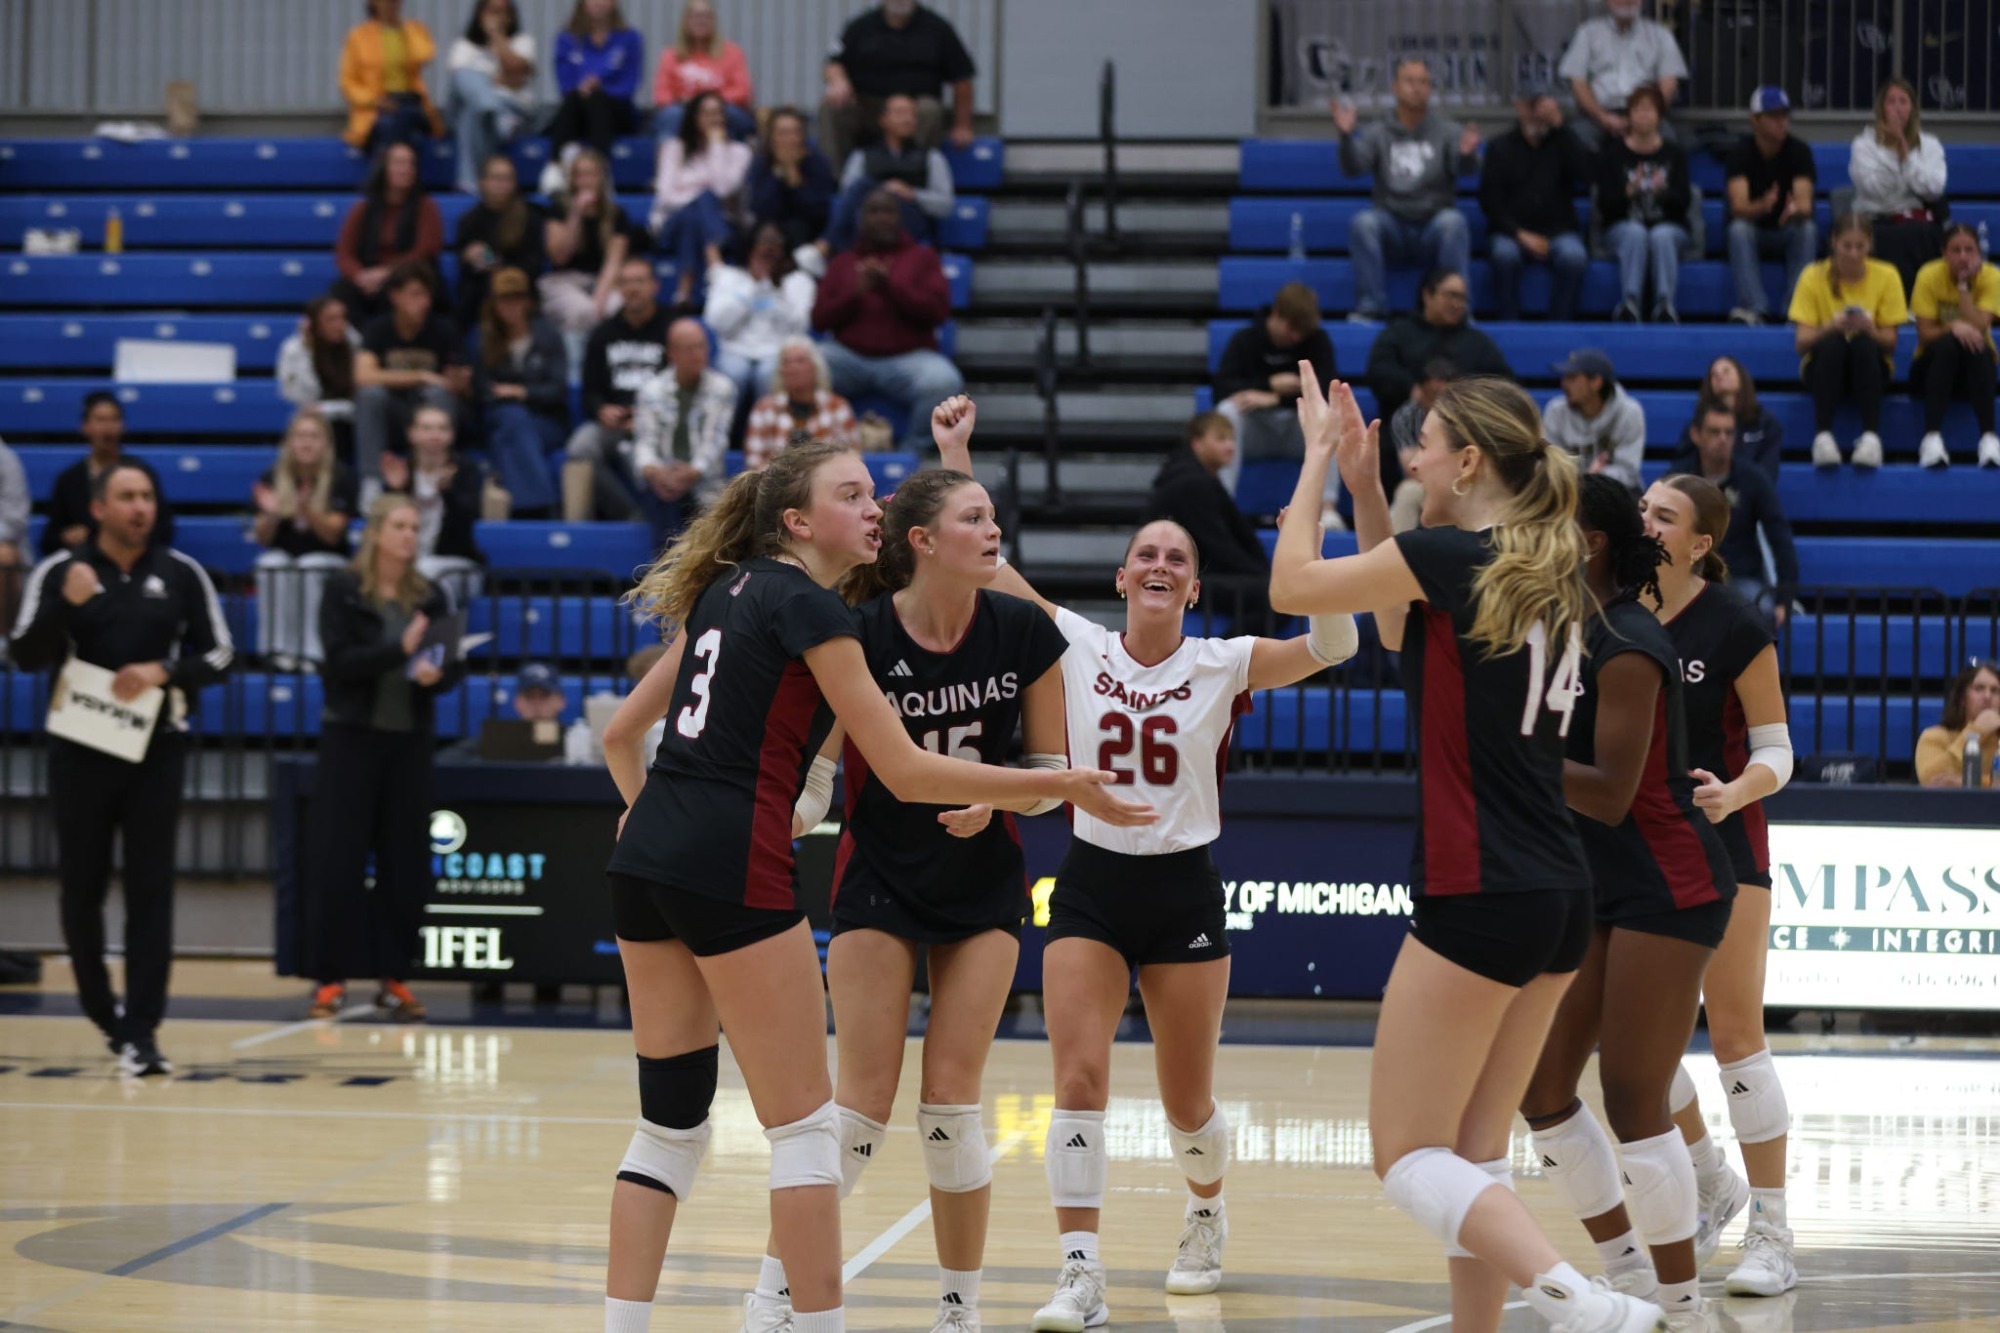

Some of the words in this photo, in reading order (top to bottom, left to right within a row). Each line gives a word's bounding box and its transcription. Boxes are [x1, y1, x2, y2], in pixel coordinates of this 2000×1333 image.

[677, 627, 722, 739] 3
[885, 671, 1018, 718] AQUINAS
[1093, 672, 1192, 711] SAINTS
[1520, 619, 1581, 737] 14
[1098, 711, 1179, 786] 26
[430, 852, 547, 881] COAST
[1777, 862, 2000, 913] MPAS
[1239, 880, 1275, 913] OF
[1277, 881, 1414, 916] MICHIGAN
[419, 926, 515, 970] IFEL
[1872, 928, 2000, 953] INTEGRI
